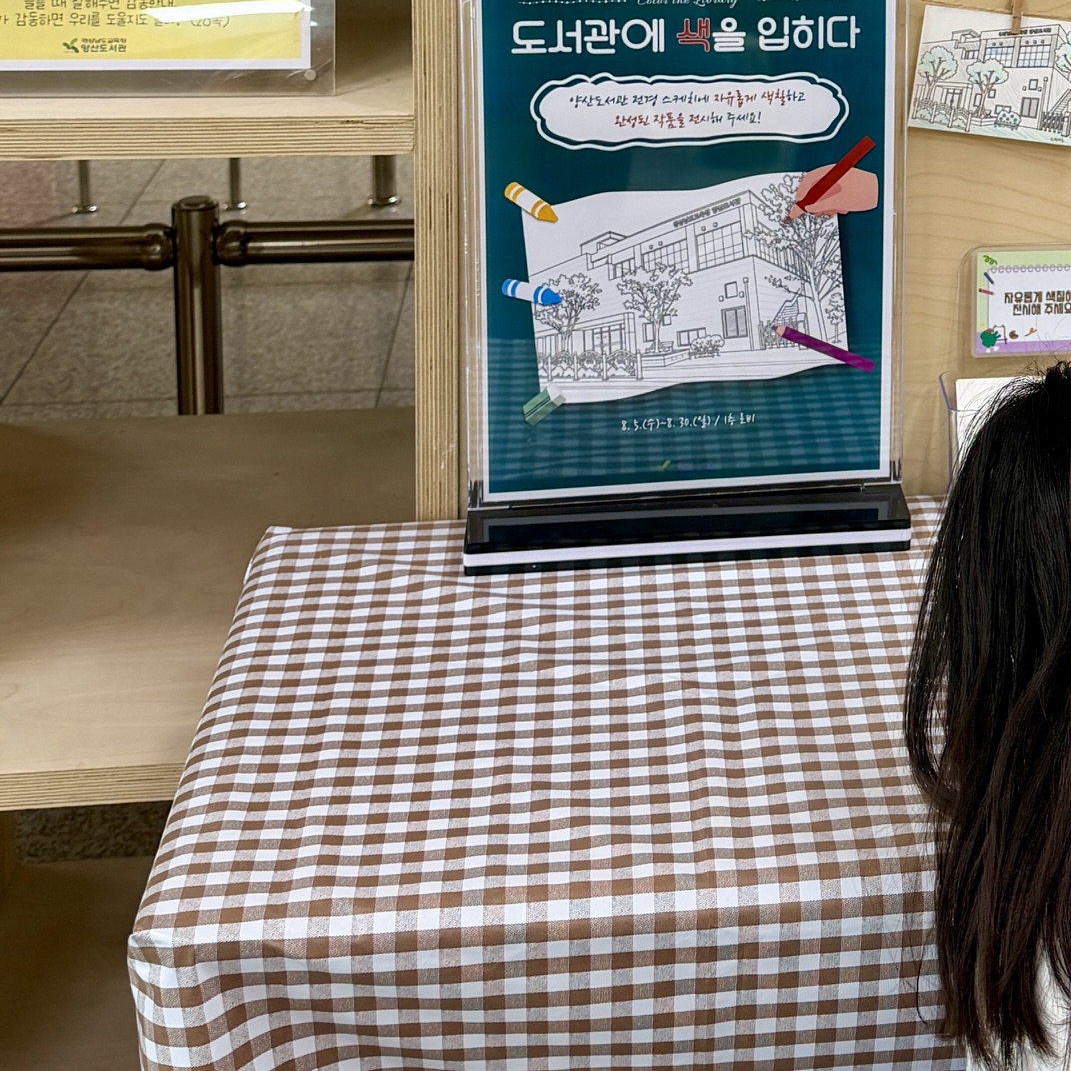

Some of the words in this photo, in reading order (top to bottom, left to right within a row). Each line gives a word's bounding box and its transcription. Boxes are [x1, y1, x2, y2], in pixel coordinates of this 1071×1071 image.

[15, 13, 64, 27] 감동하면
[68, 12, 100, 27] 우리를
[106, 12, 148, 27] 도울지도
[511, 18, 665, 55] 도서관에
[676, 17, 747, 53] 색을
[757, 15, 861, 50] 입히다
[80, 44, 127, 53] 양산도서관
[569, 94, 628, 108] 양산도서관
[632, 94, 658, 107] 전경
[662, 92, 710, 105] 스케치에
[714, 90, 757, 109] 자유롭게
[761, 89, 807, 107] 색칠하고
[614, 113, 650, 128] 완성된
[653, 111, 685, 129] 작품을
[688, 112, 723, 126] 전시해
[726, 111, 762, 127] 주세요!
[1004, 291, 1043, 304] 자유롭게
[1013, 303, 1041, 316] 전시해
[740, 412, 756, 425] 로비
